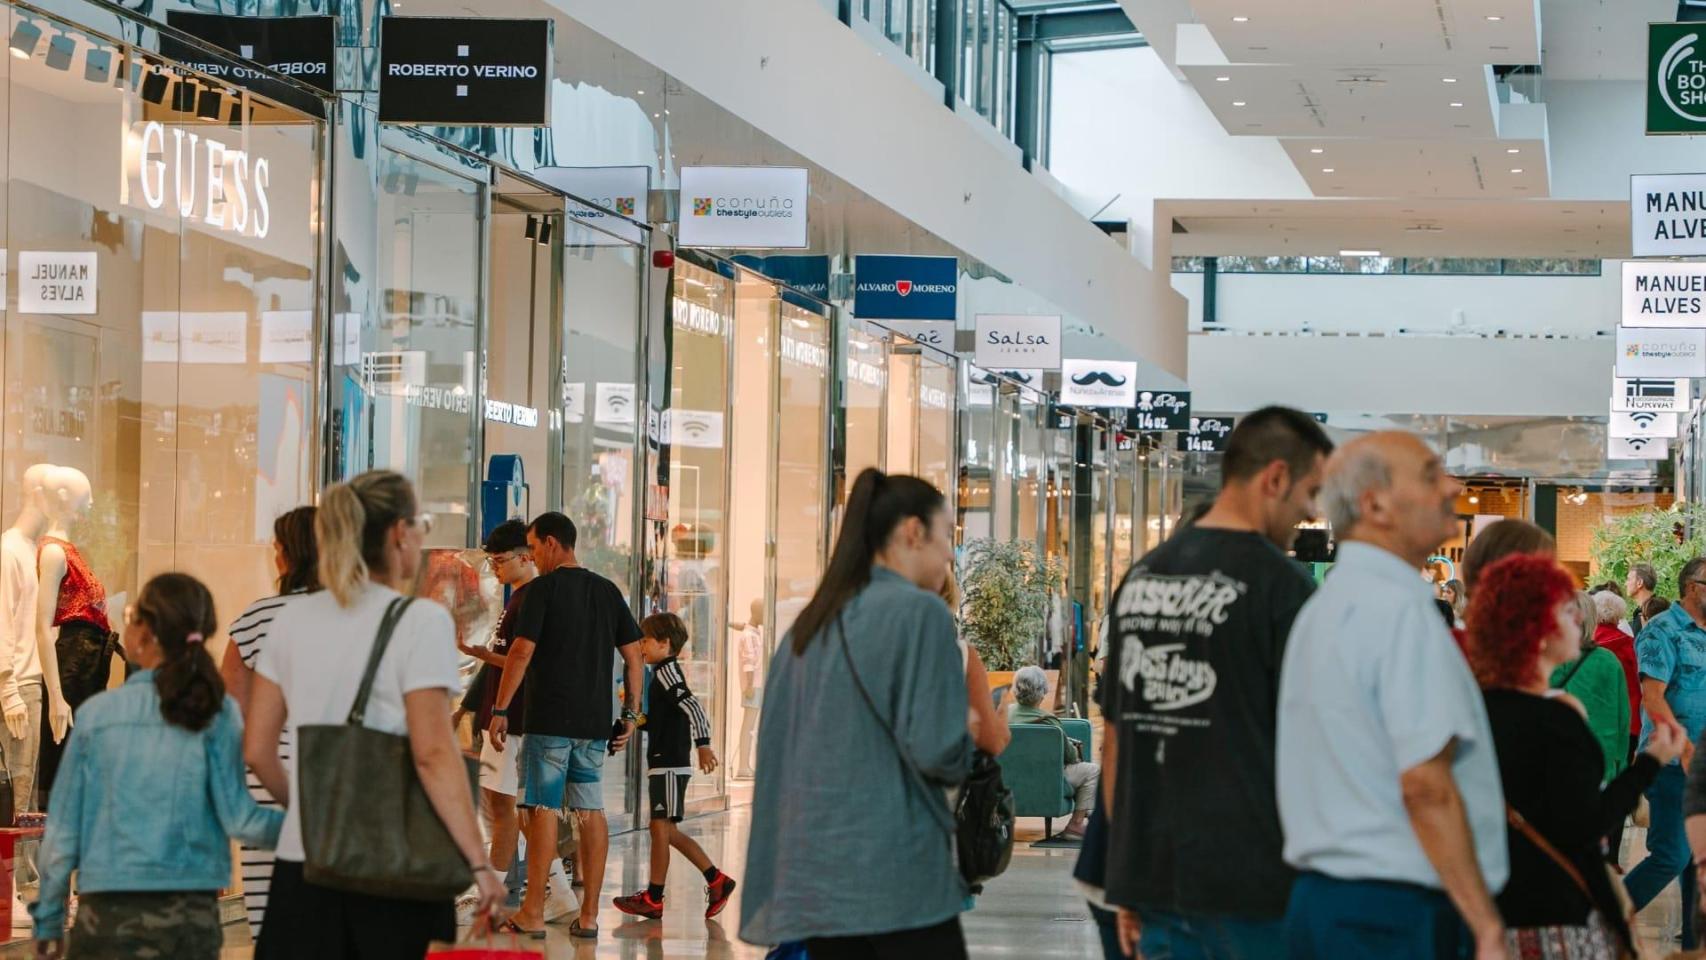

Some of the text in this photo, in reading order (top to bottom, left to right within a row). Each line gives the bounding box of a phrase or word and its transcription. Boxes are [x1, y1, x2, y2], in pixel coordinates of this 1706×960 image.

[388, 64, 538, 78] ROBERTO VERINO
[1680, 91, 1706, 105] SH
[140, 121, 270, 239] GUESS
[716, 196, 793, 209] coruña
[857, 283, 956, 293] ALVARO MORENO
[1641, 297, 1701, 314] ALVES
[987, 330, 1049, 345] Salsa
